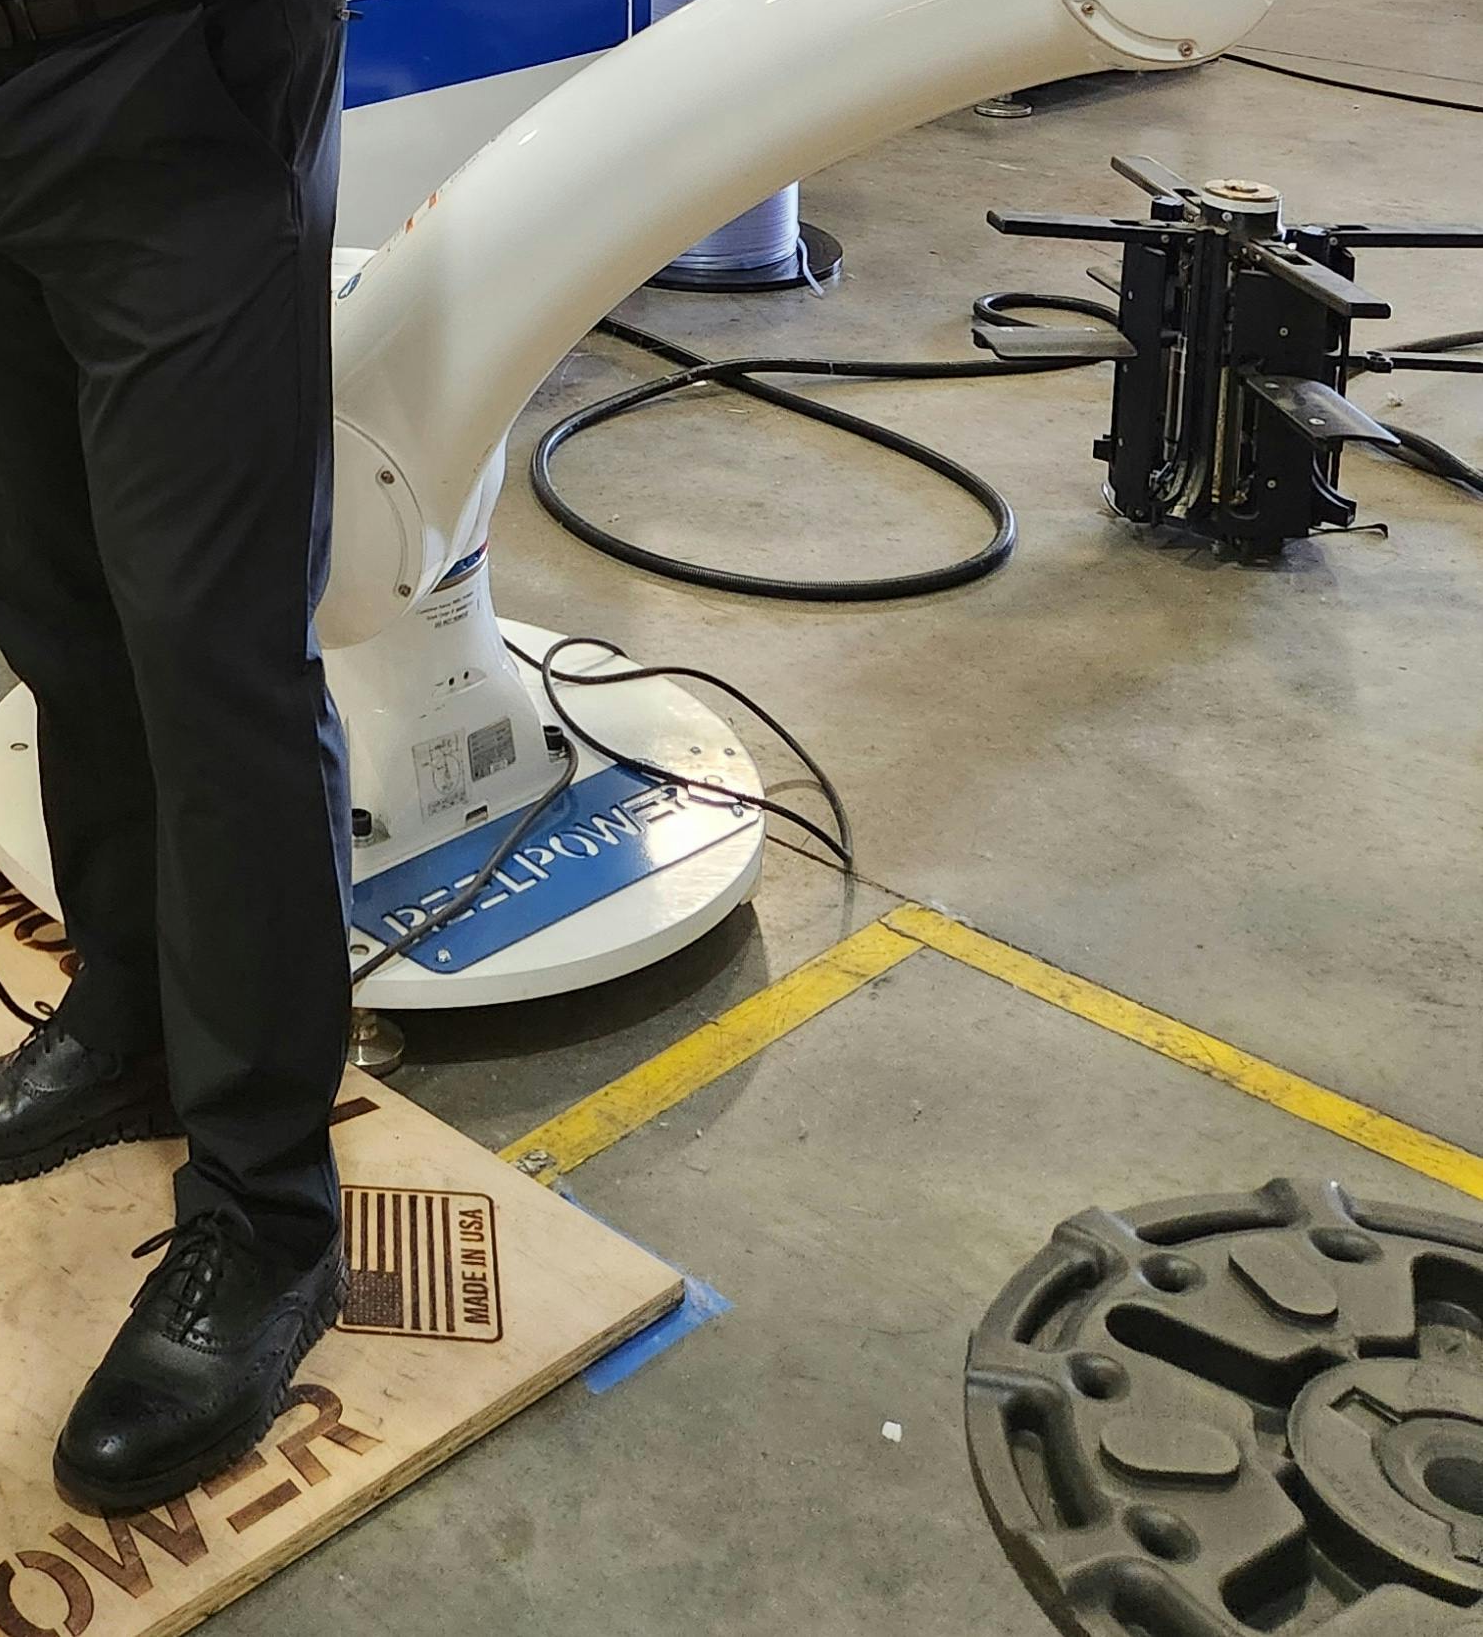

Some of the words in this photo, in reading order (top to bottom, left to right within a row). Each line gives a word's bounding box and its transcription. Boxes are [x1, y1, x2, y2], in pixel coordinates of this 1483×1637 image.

[458, 1208, 485, 1243] USA
[460, 1248, 487, 1267] IN
[461, 1270, 491, 1326] MADE
